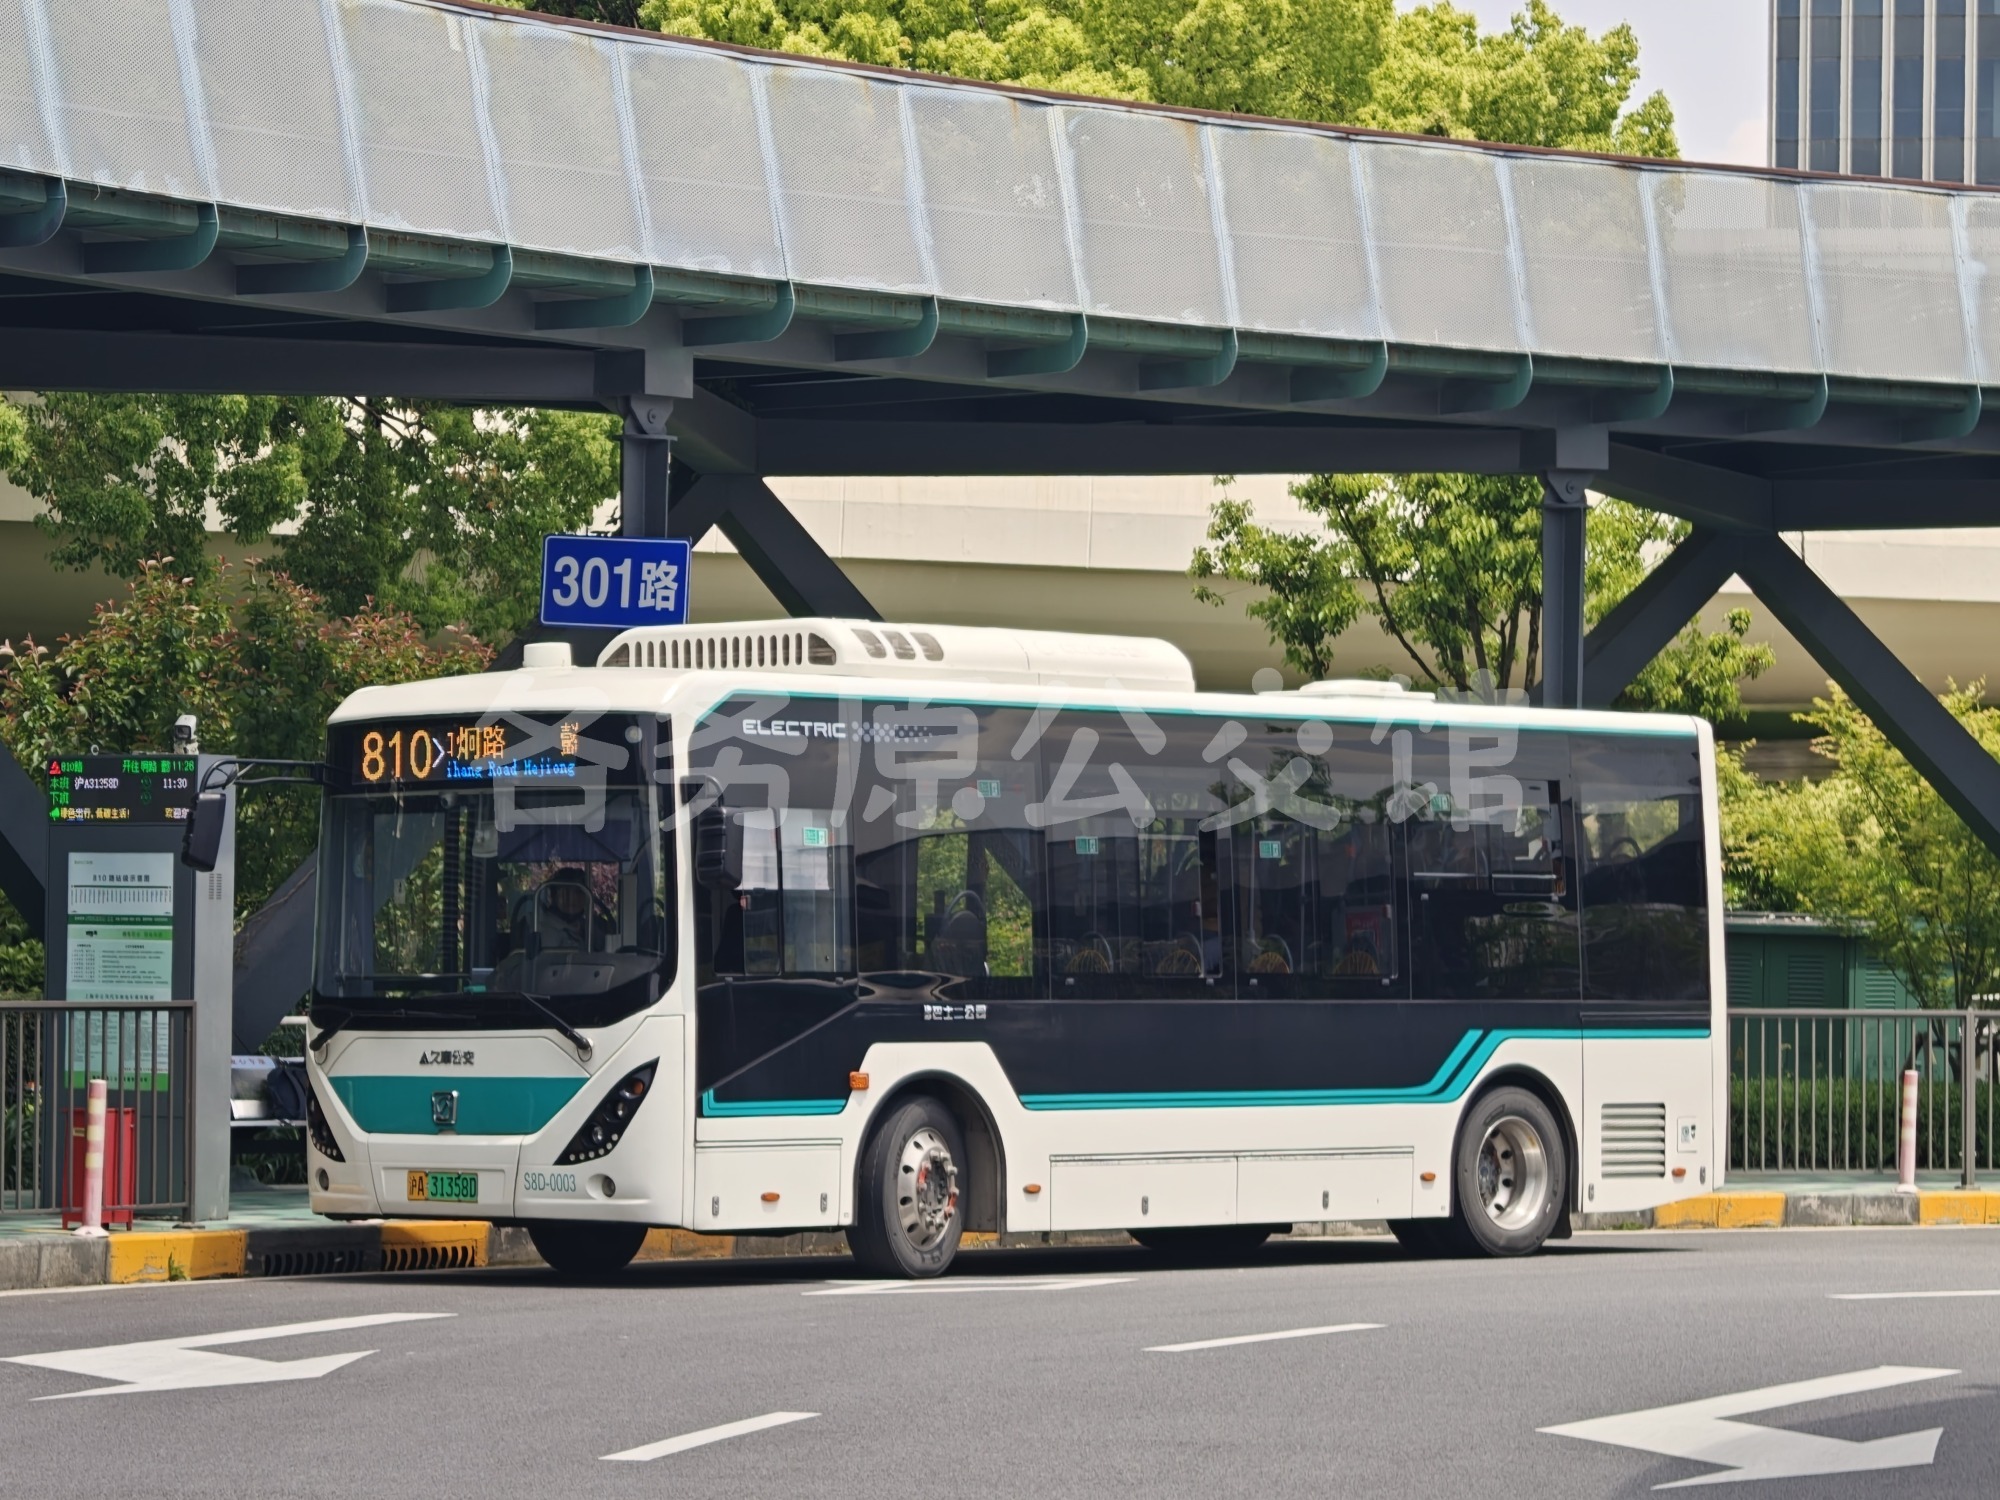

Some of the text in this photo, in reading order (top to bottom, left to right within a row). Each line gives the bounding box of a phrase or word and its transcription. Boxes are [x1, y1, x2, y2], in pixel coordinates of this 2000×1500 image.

[552, 555, 679, 612] 301路
[742, 719, 847, 739] ELECTRIC
[362, 729, 432, 781] 810
[487, 758, 517, 777] Road
[163, 778, 188, 789] 11:30
[523, 1172, 577, 1192] S8D-0003
